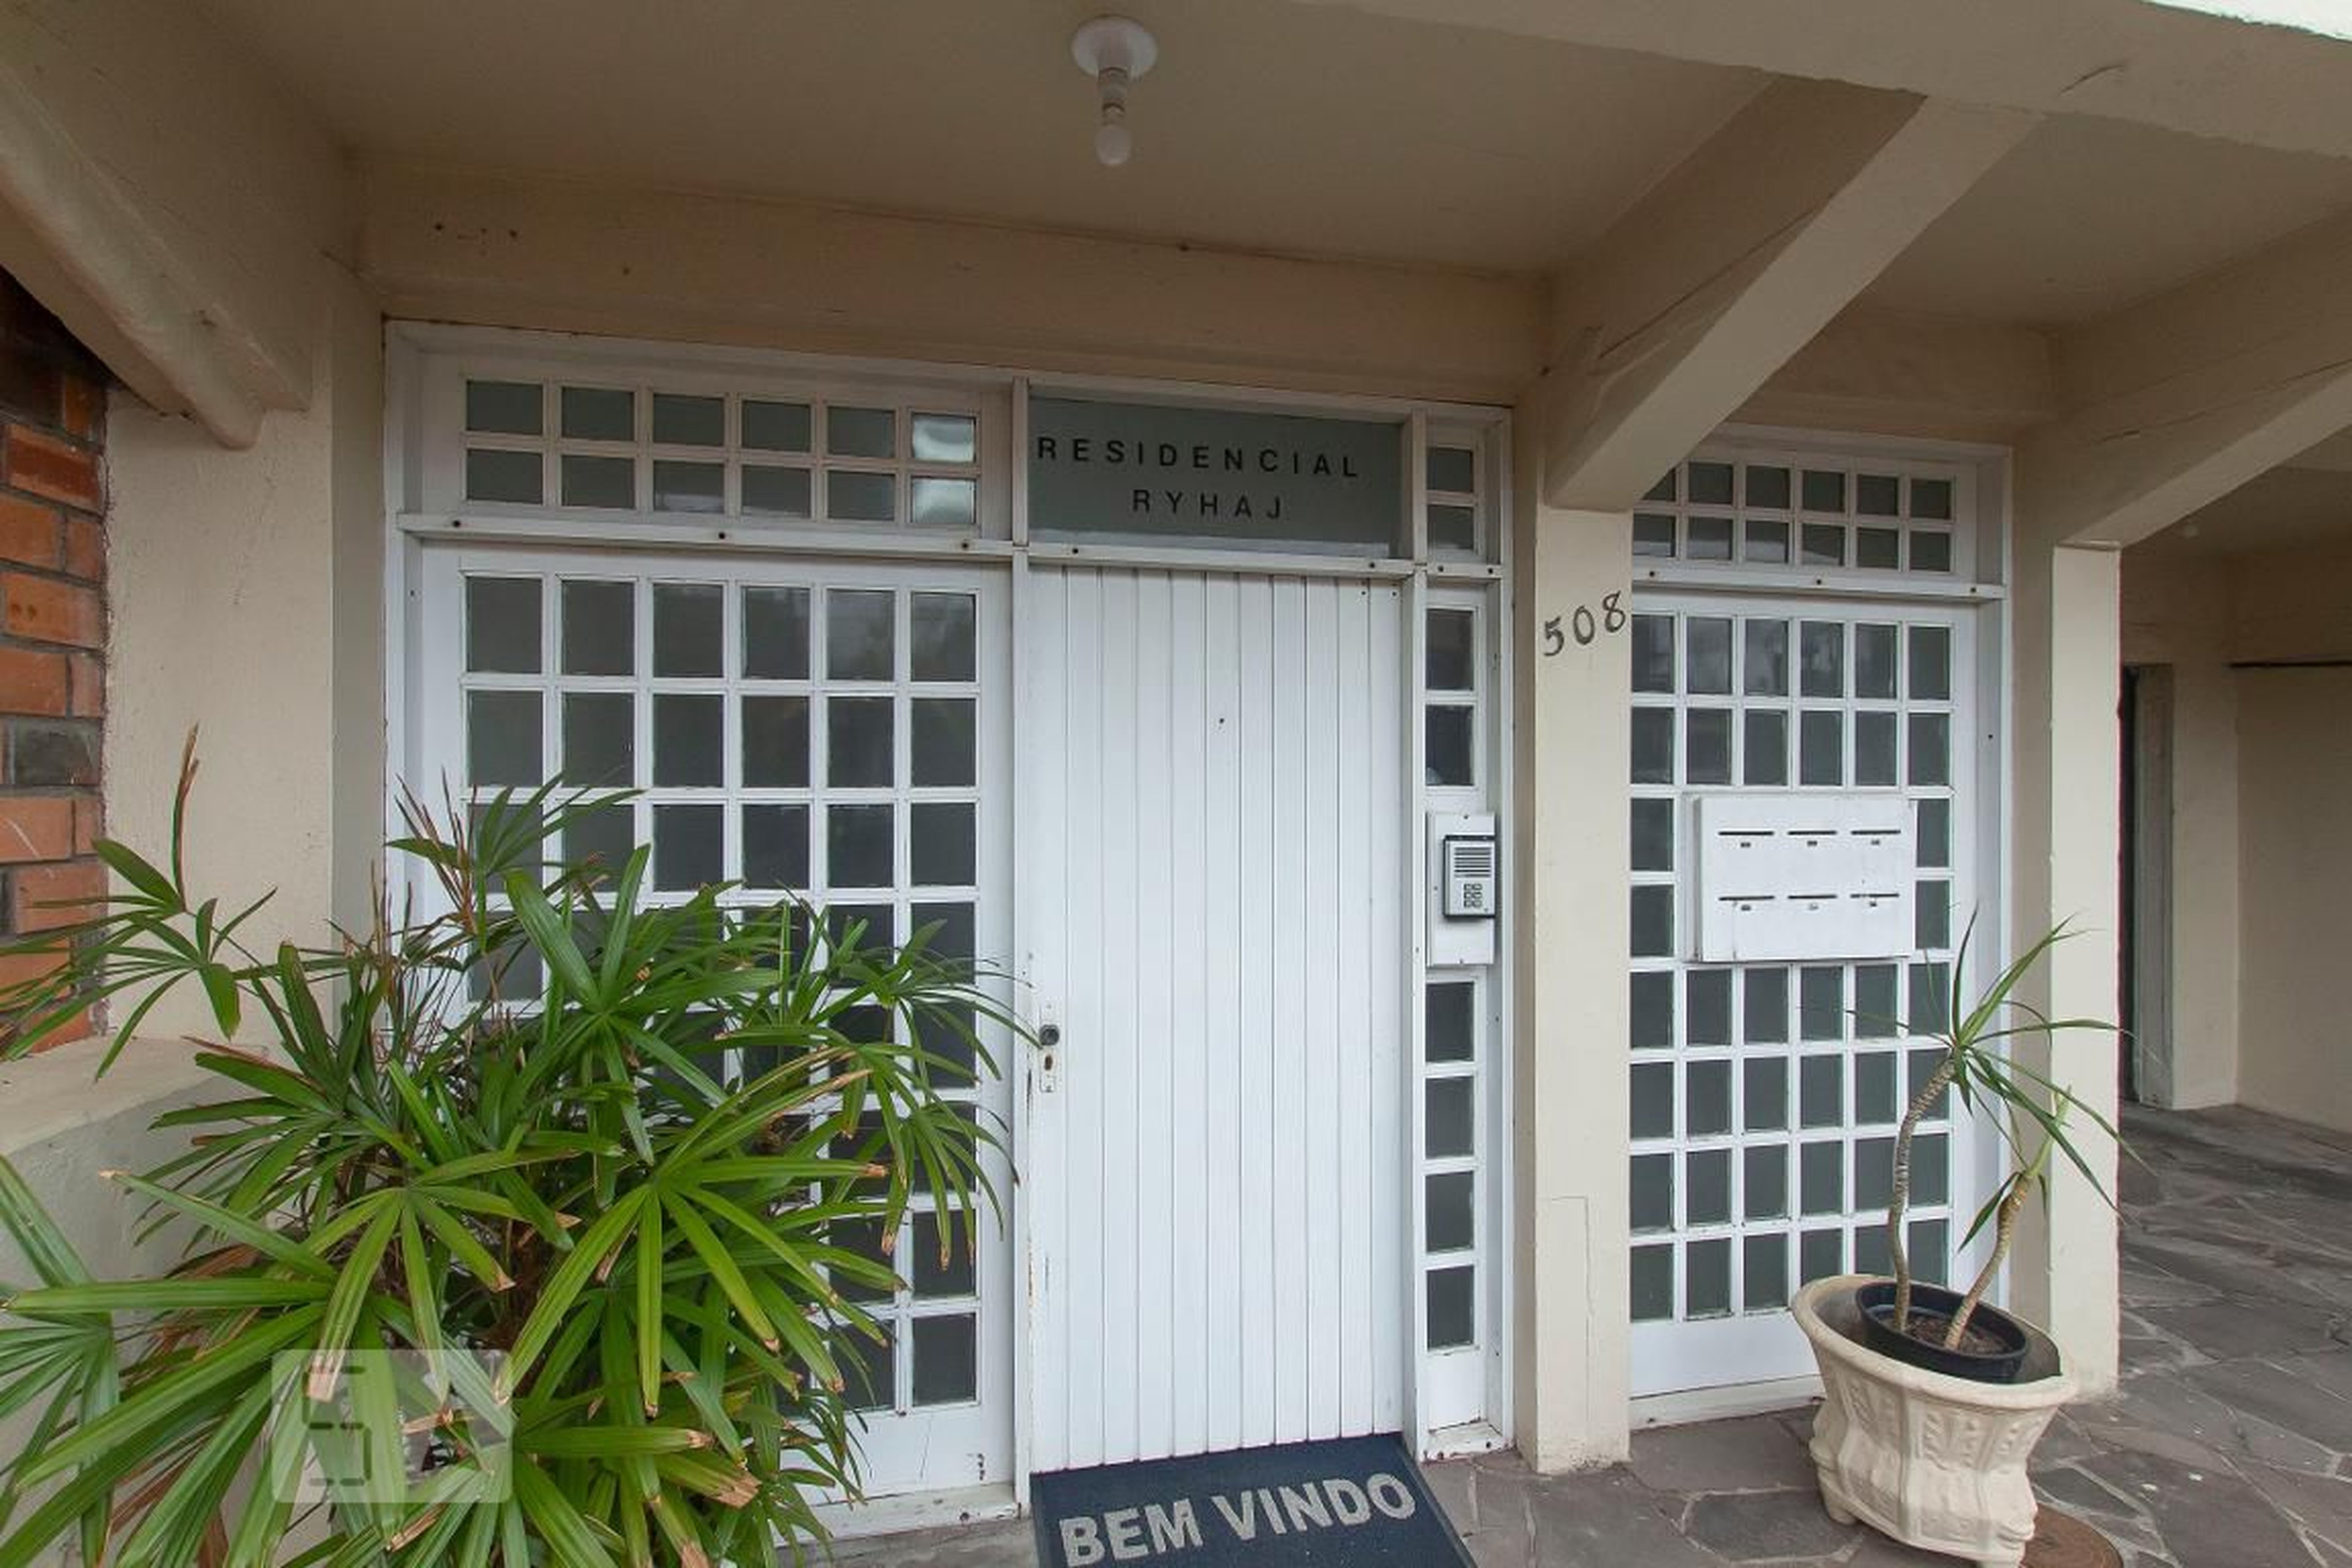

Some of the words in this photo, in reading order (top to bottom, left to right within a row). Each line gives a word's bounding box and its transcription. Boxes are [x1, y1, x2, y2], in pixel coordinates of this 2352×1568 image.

[1038, 437, 1358, 478] RESIDENCIAL
[1133, 489, 1281, 519] RYHAJ
[1544, 590, 1626, 657] 508
[1058, 1498, 1204, 1567] BEM
[1212, 1473, 1416, 1542] VINDO
